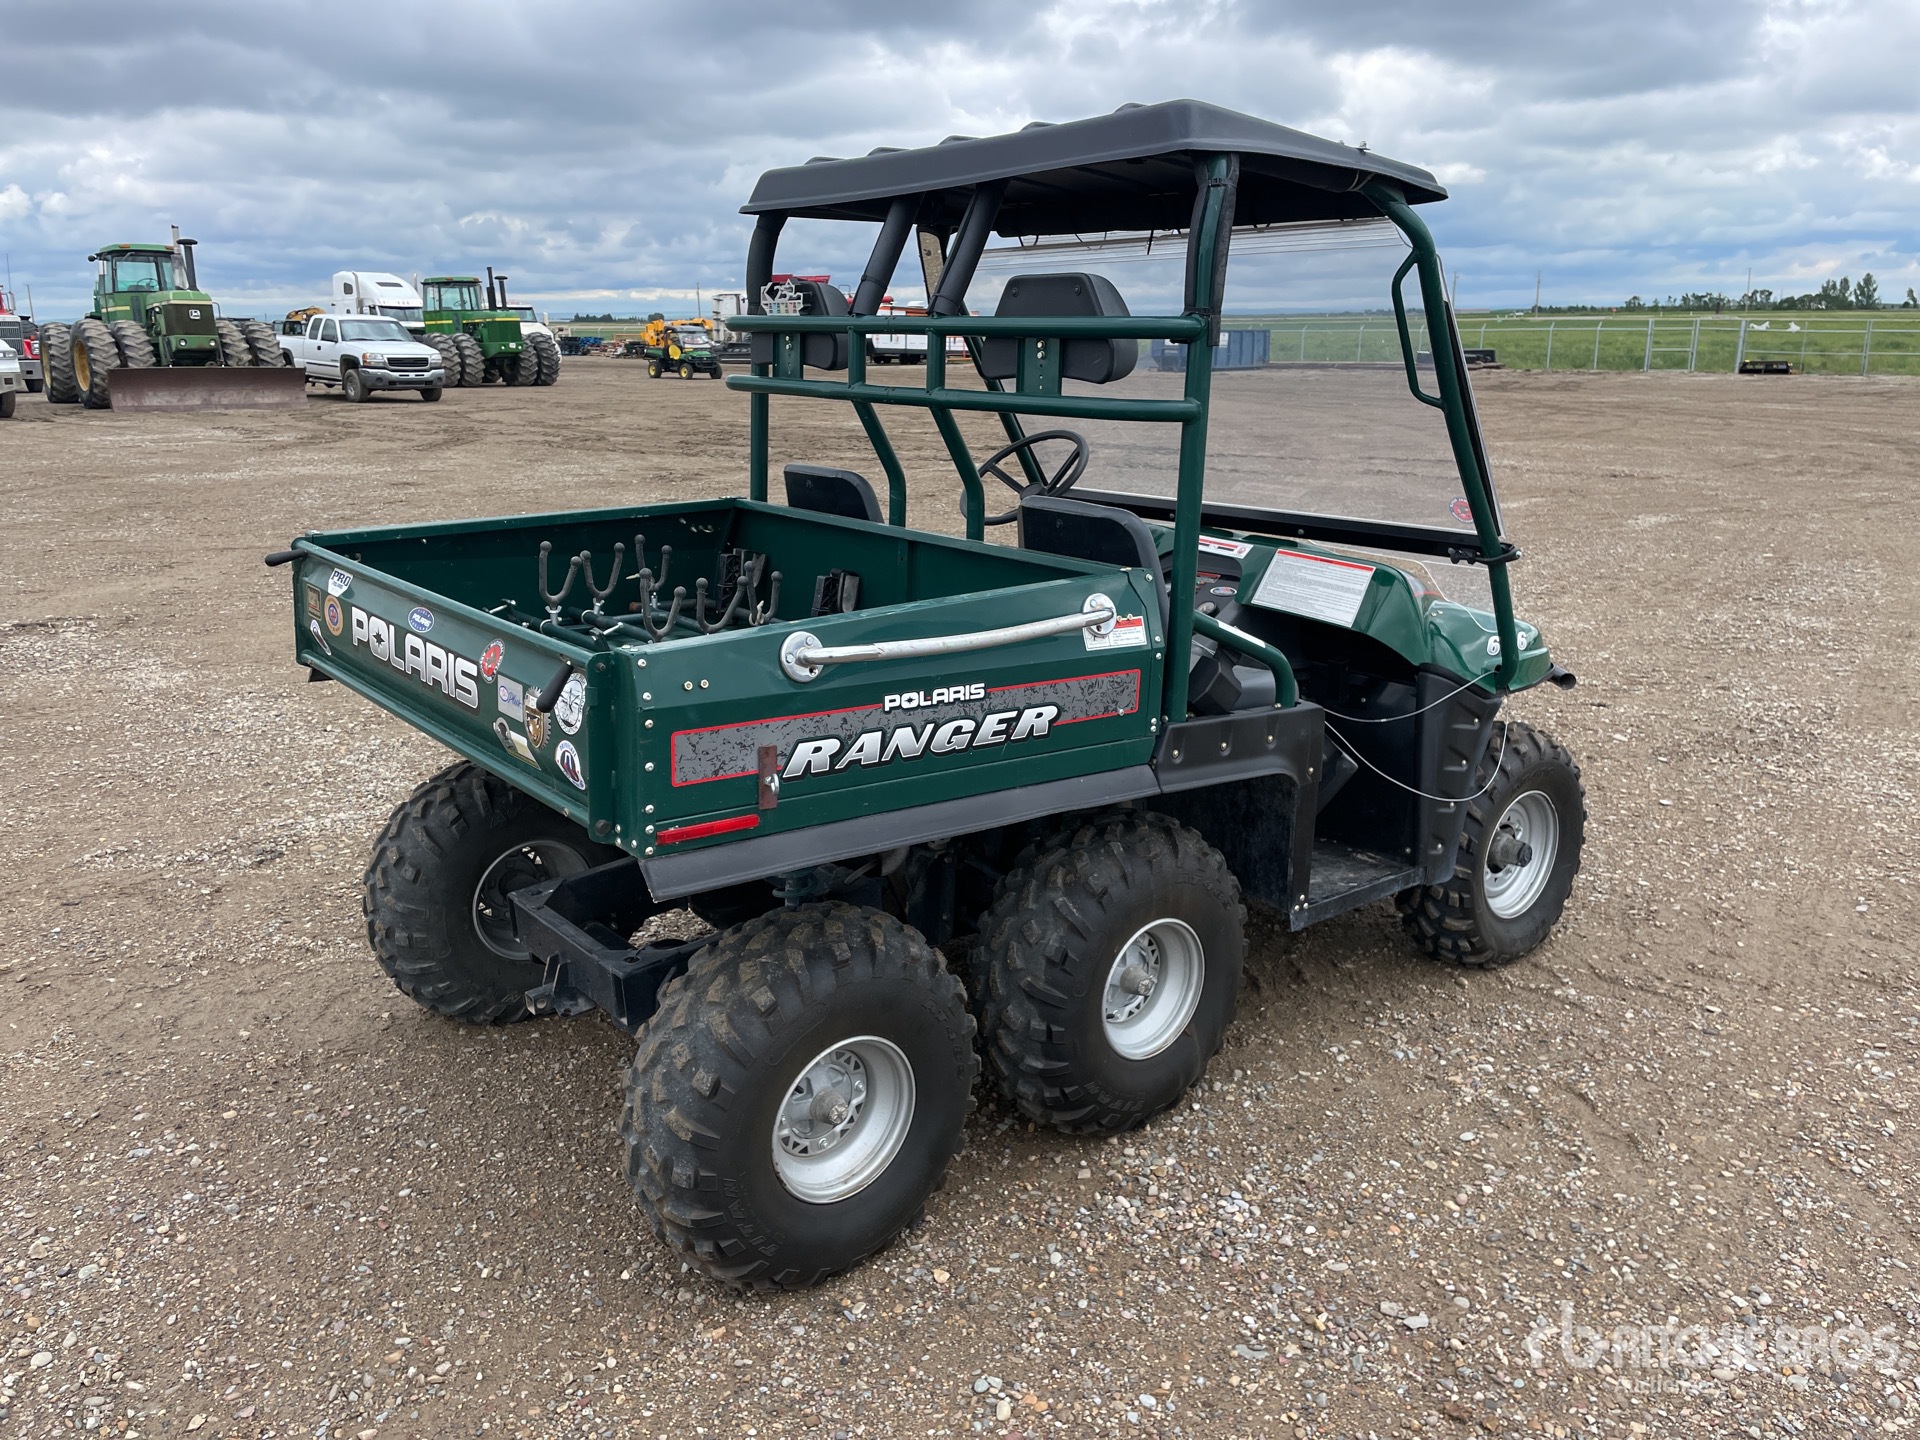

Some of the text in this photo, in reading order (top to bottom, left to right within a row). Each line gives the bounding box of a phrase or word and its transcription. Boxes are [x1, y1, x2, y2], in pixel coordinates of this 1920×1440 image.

[331, 571, 352, 587] PRO
[411, 613, 432, 627] POLARIS
[351, 606, 479, 709] POLARIS
[884, 683, 986, 712] POLARIS
[782, 705, 1059, 778] RANGER
[722, 1178, 779, 1257] TITAN
